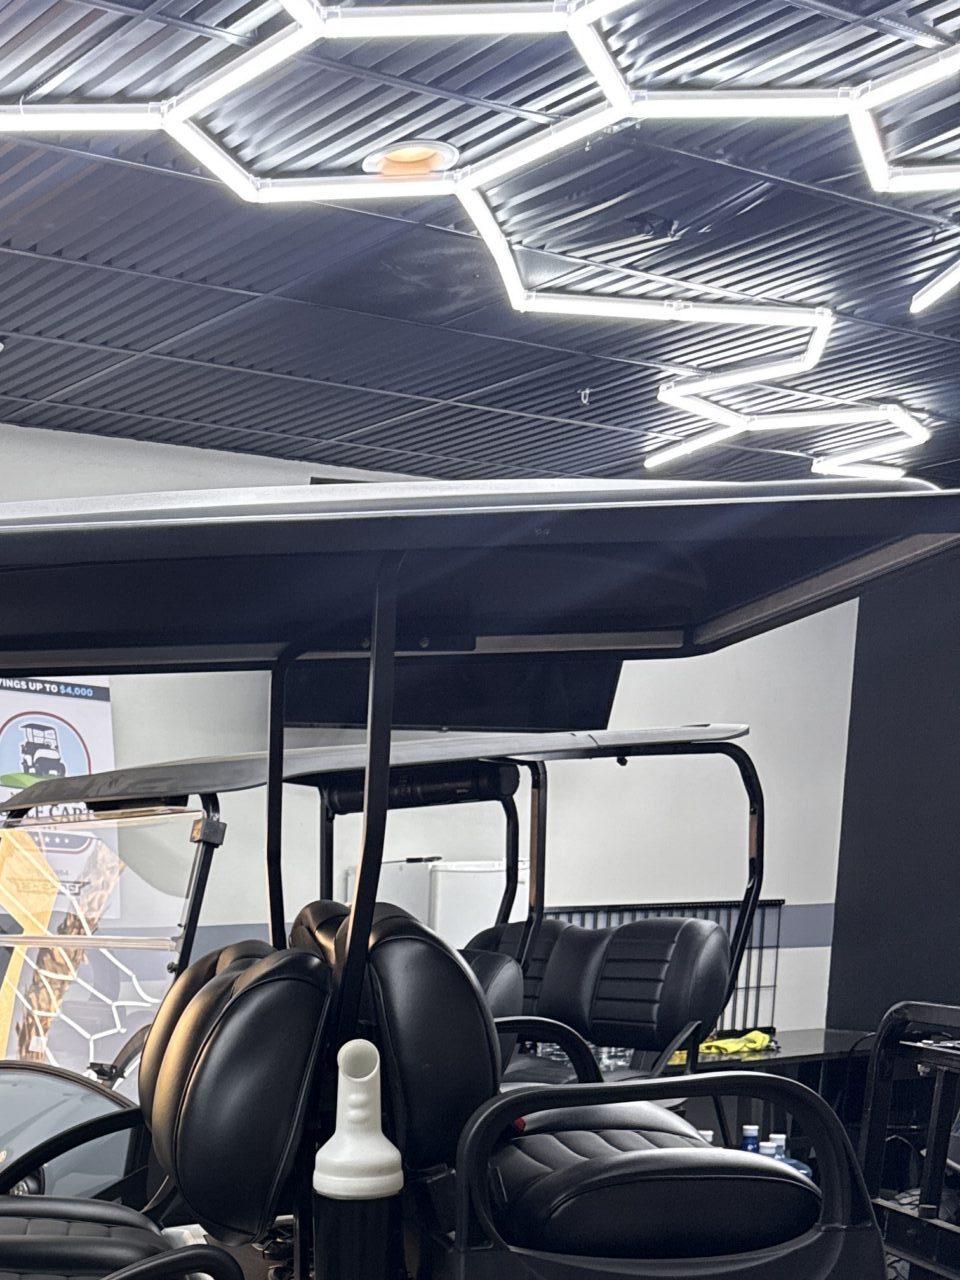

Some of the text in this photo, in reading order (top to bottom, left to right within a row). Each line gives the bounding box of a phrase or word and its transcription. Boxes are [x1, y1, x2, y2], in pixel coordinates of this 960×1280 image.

[28, 682, 43, 691] UP
[44, 684, 58, 692] TO
[59, 685, 93, 697] $4,000
